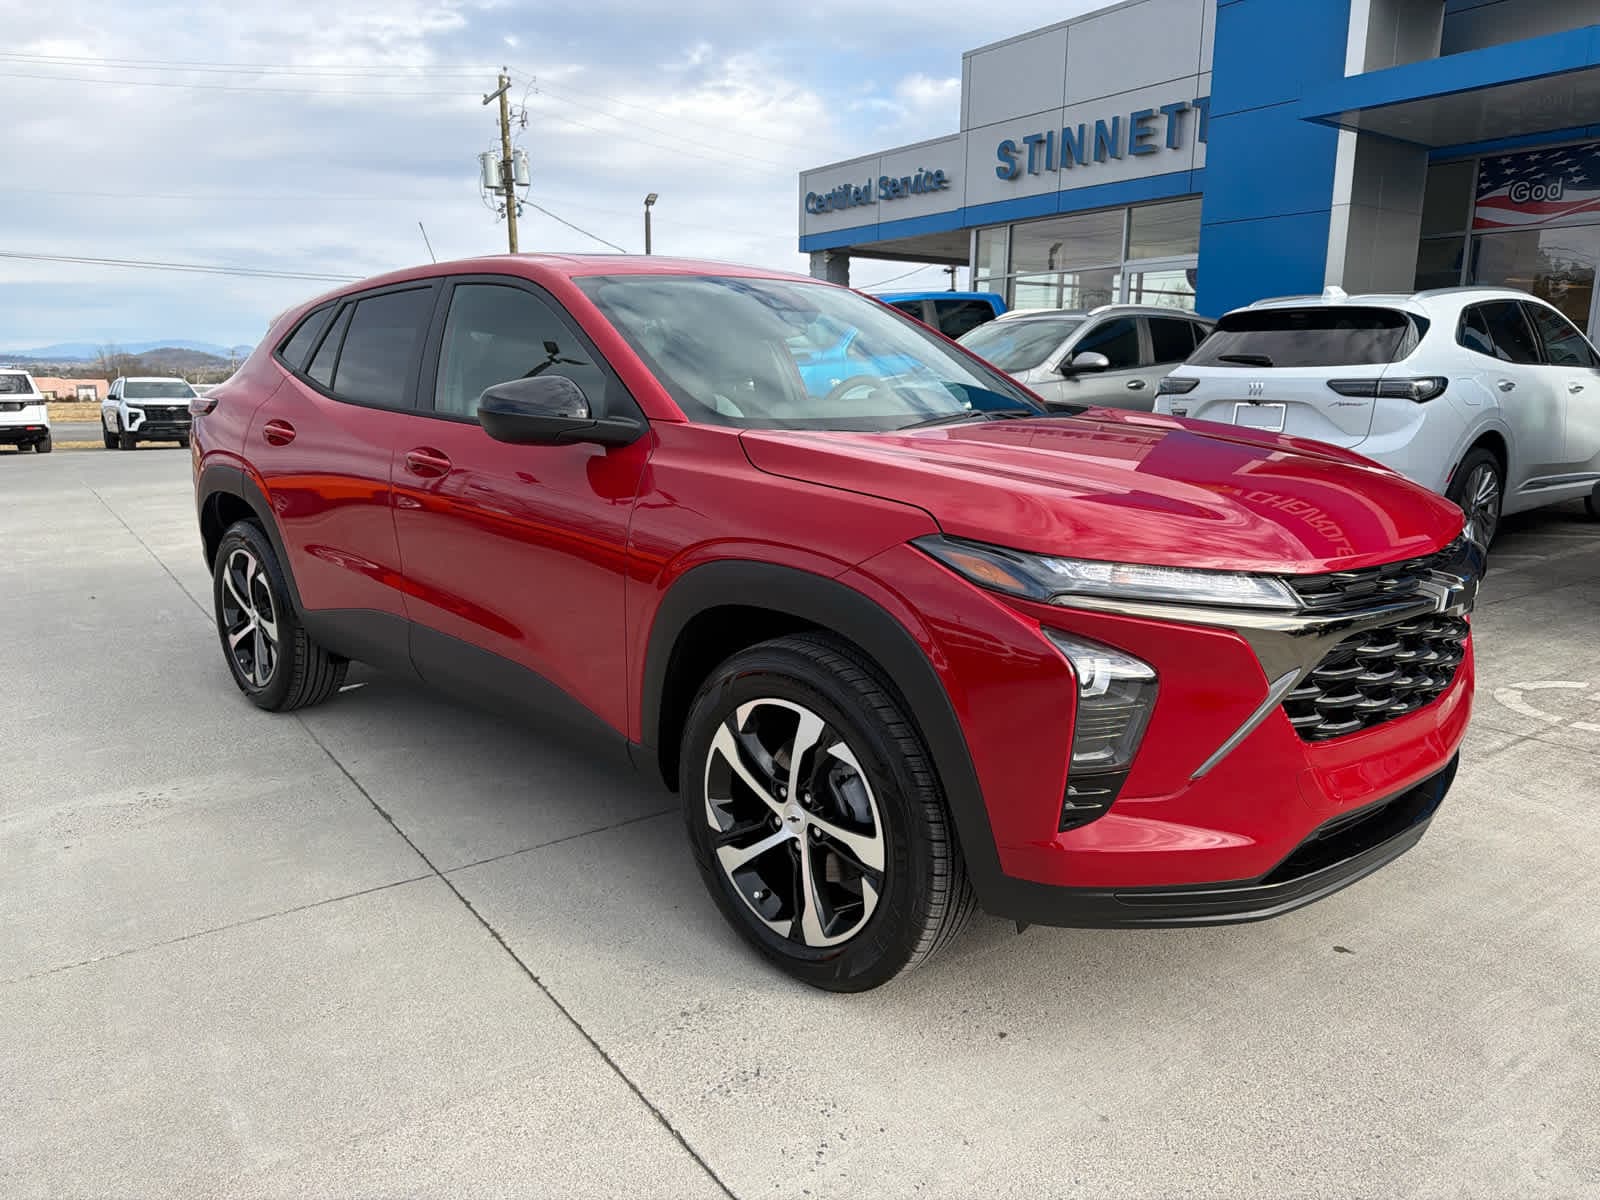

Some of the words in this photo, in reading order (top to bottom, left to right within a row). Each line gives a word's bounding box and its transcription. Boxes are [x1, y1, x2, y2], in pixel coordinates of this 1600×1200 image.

[995, 95, 1211, 181] STINNETT
[805, 177, 874, 214] Certified
[878, 167, 947, 200] Service
[1510, 177, 1564, 203] God
